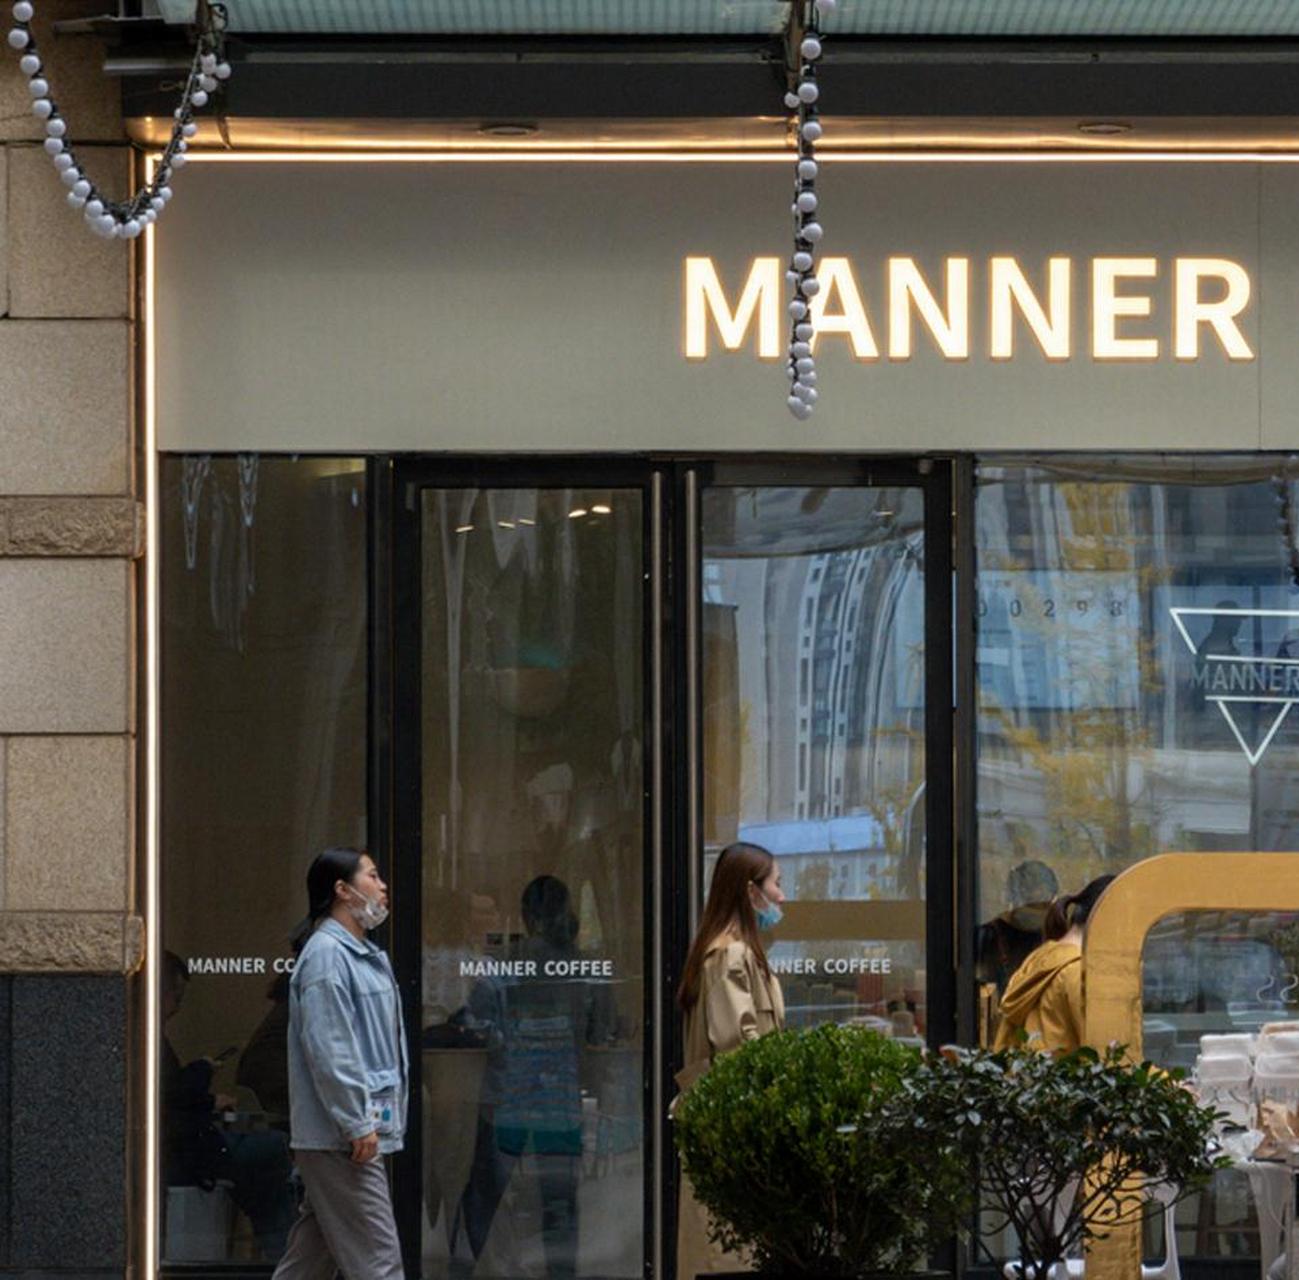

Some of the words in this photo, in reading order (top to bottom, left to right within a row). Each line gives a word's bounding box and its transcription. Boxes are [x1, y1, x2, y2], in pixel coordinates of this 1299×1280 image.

[683, 256, 1255, 359] MANNER
[187, 957, 266, 975] MANNER
[459, 960, 537, 977] MANNER
[544, 960, 613, 977] COFFEE
[767, 958, 816, 975] NNER
[823, 958, 892, 975] COFFEE
